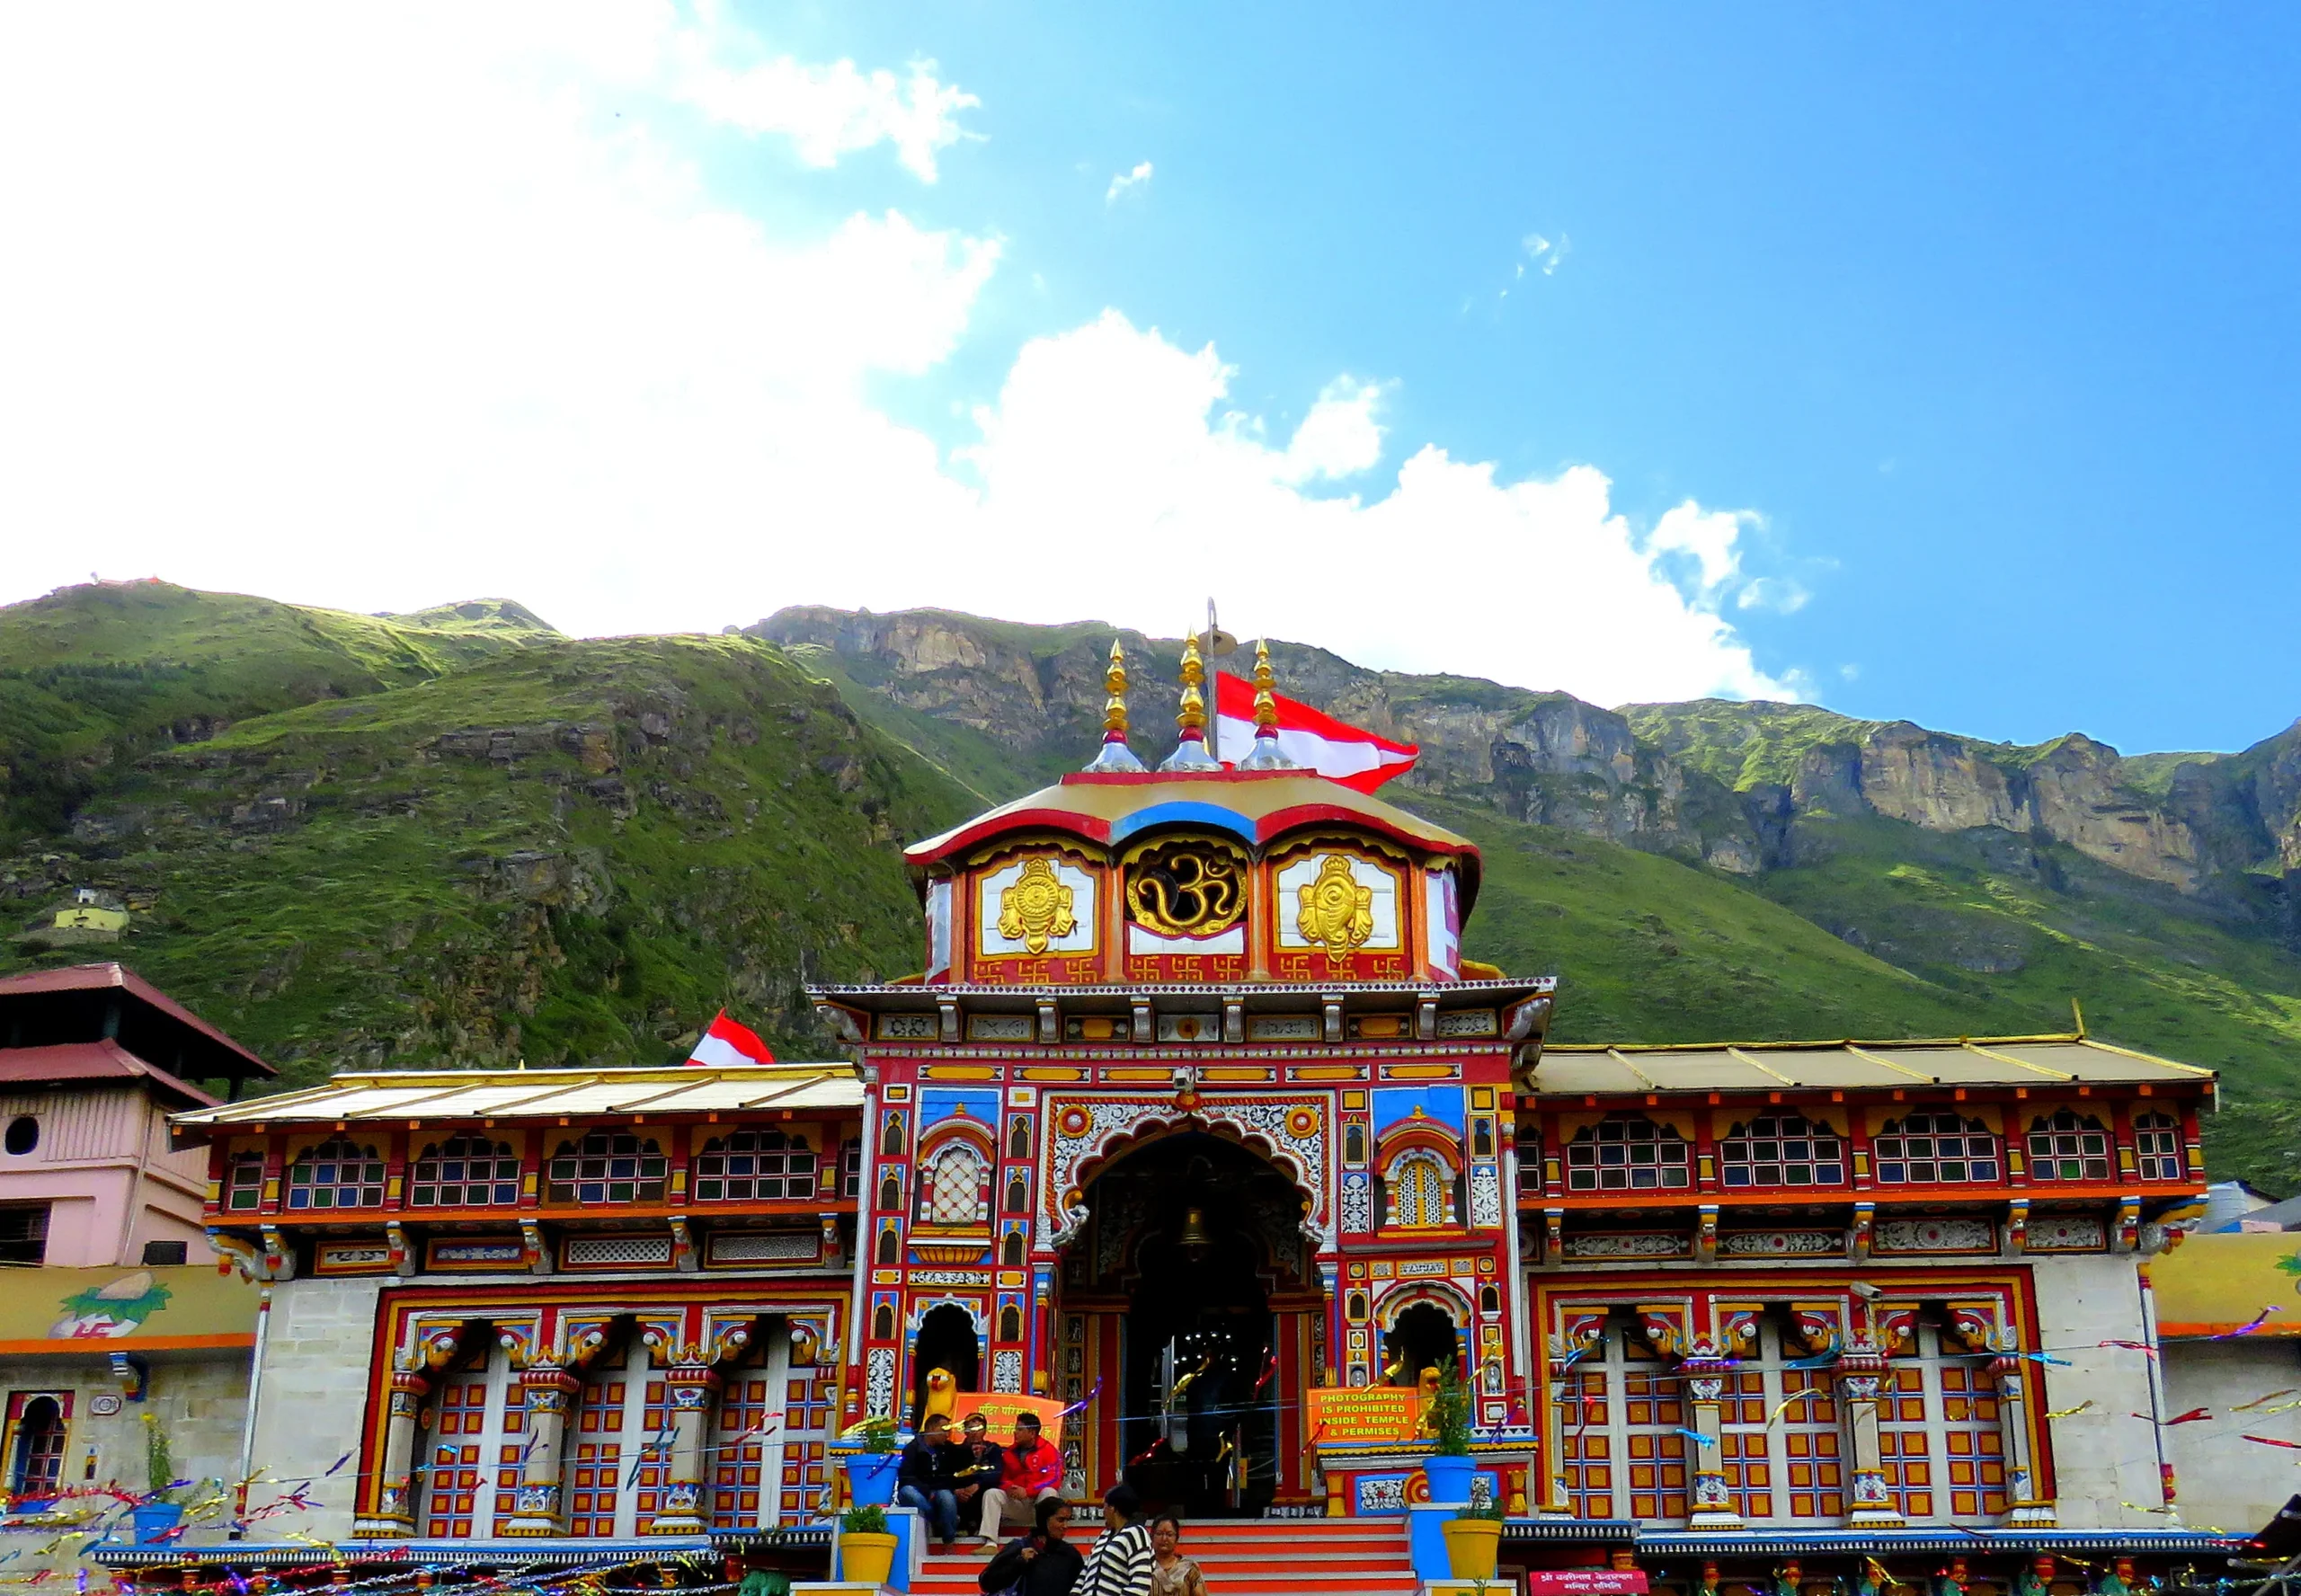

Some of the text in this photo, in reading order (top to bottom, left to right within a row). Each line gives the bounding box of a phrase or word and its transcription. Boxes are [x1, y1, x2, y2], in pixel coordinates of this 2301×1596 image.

[1320, 1394, 1406, 1402] PHOTOGRAPHY
[1322, 1405, 1406, 1414] IS PROHIBITED
[1319, 1416, 1409, 1424] INSIDE TEMPLE
[1330, 1427, 1399, 1436] & PERMISES
[1540, 1572, 1553, 1582] श्री
